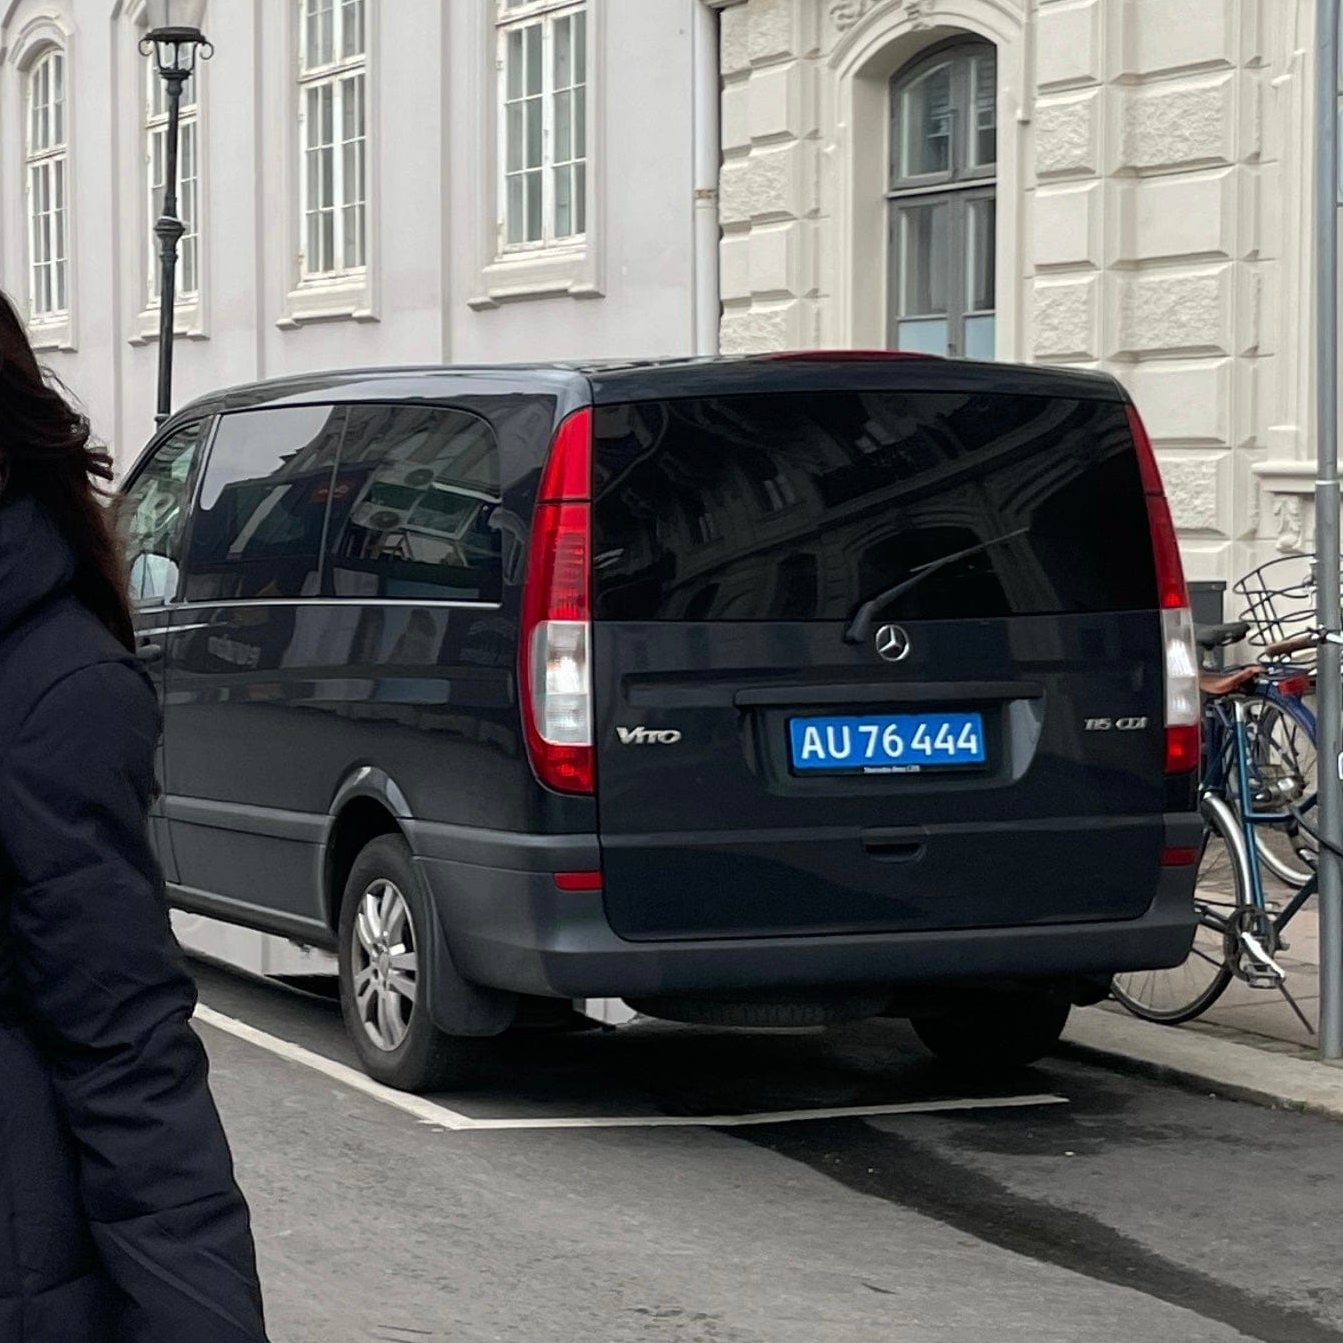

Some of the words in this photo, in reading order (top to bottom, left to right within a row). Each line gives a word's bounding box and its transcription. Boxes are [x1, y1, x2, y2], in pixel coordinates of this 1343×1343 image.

[1116, 717, 1148, 730] CDI
[801, 725, 851, 759] AU
[858, 724, 904, 758] 76
[910, 722, 978, 755] 444
